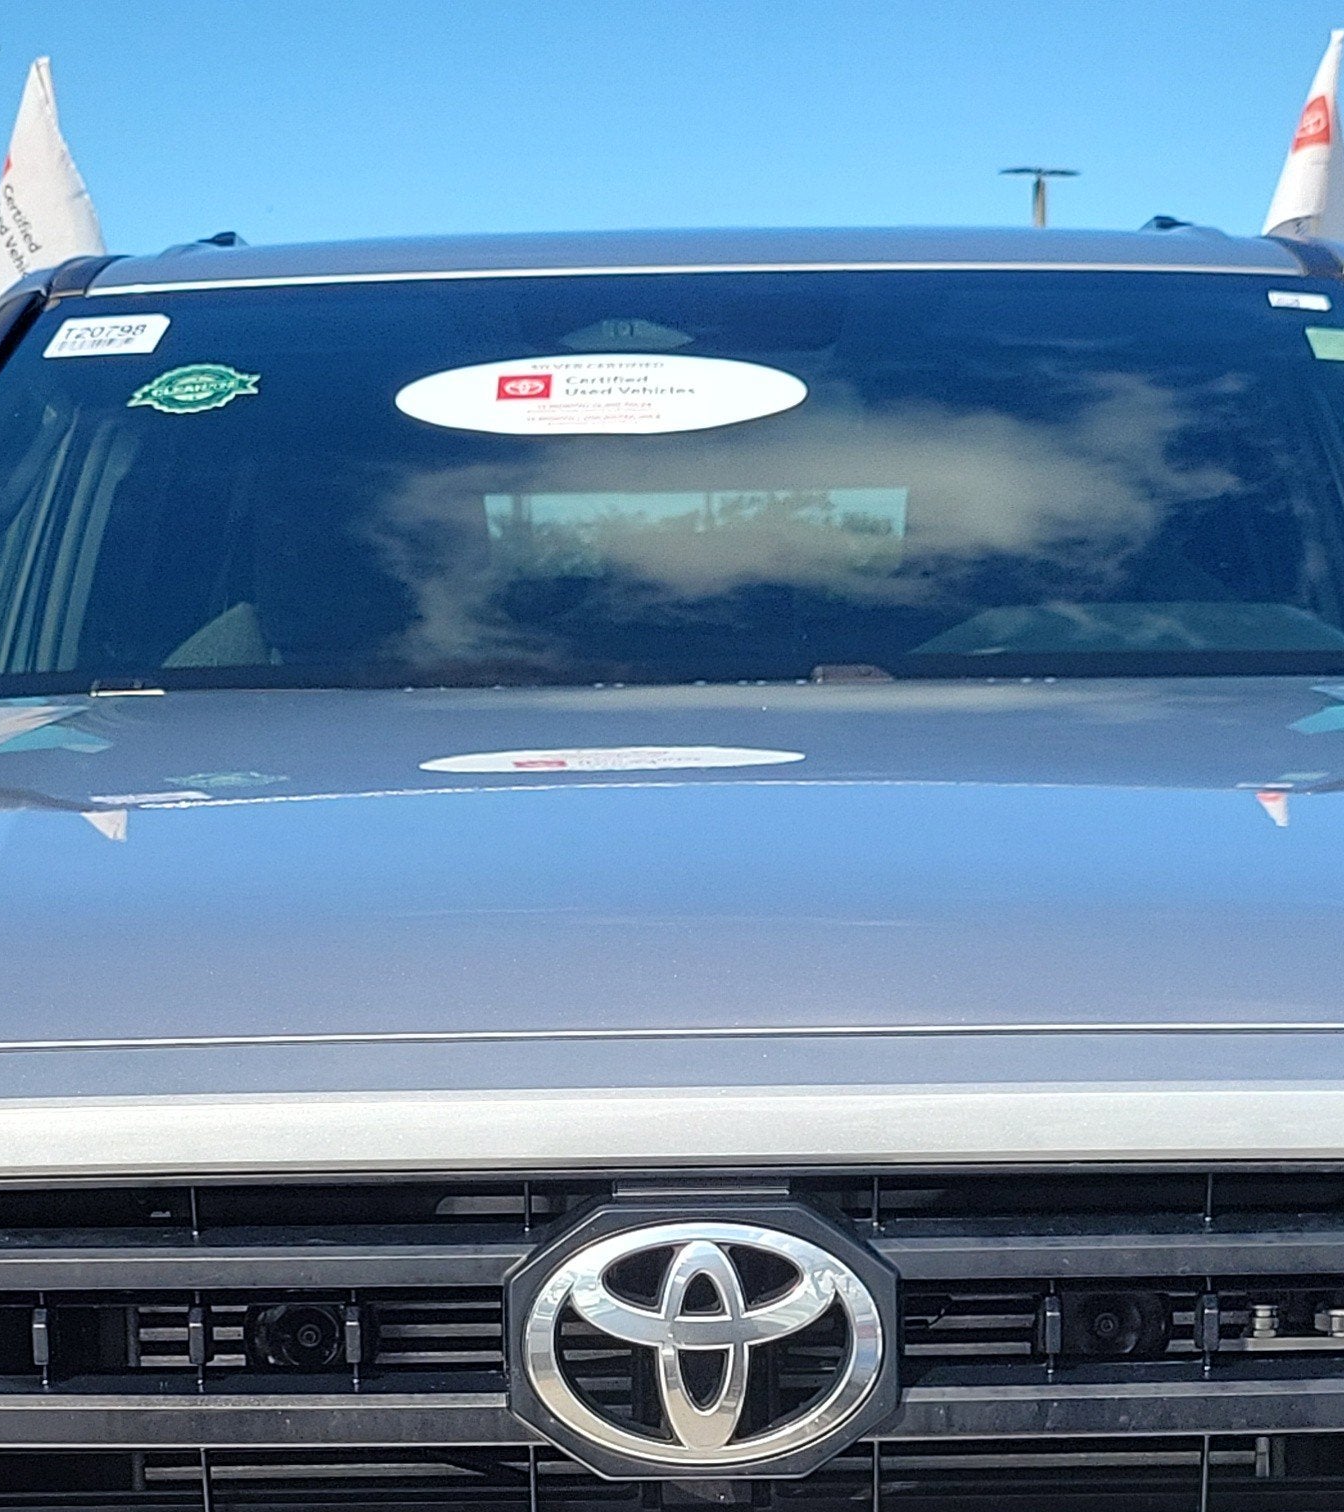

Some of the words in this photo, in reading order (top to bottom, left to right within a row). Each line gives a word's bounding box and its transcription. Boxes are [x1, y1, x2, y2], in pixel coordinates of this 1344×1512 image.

[3, 184, 43, 253] Certified
[64, 324, 147, 340] T20798
[565, 375, 649, 385] Certified
[565, 387, 612, 396] Used
[619, 386, 696, 395] Vehicles
